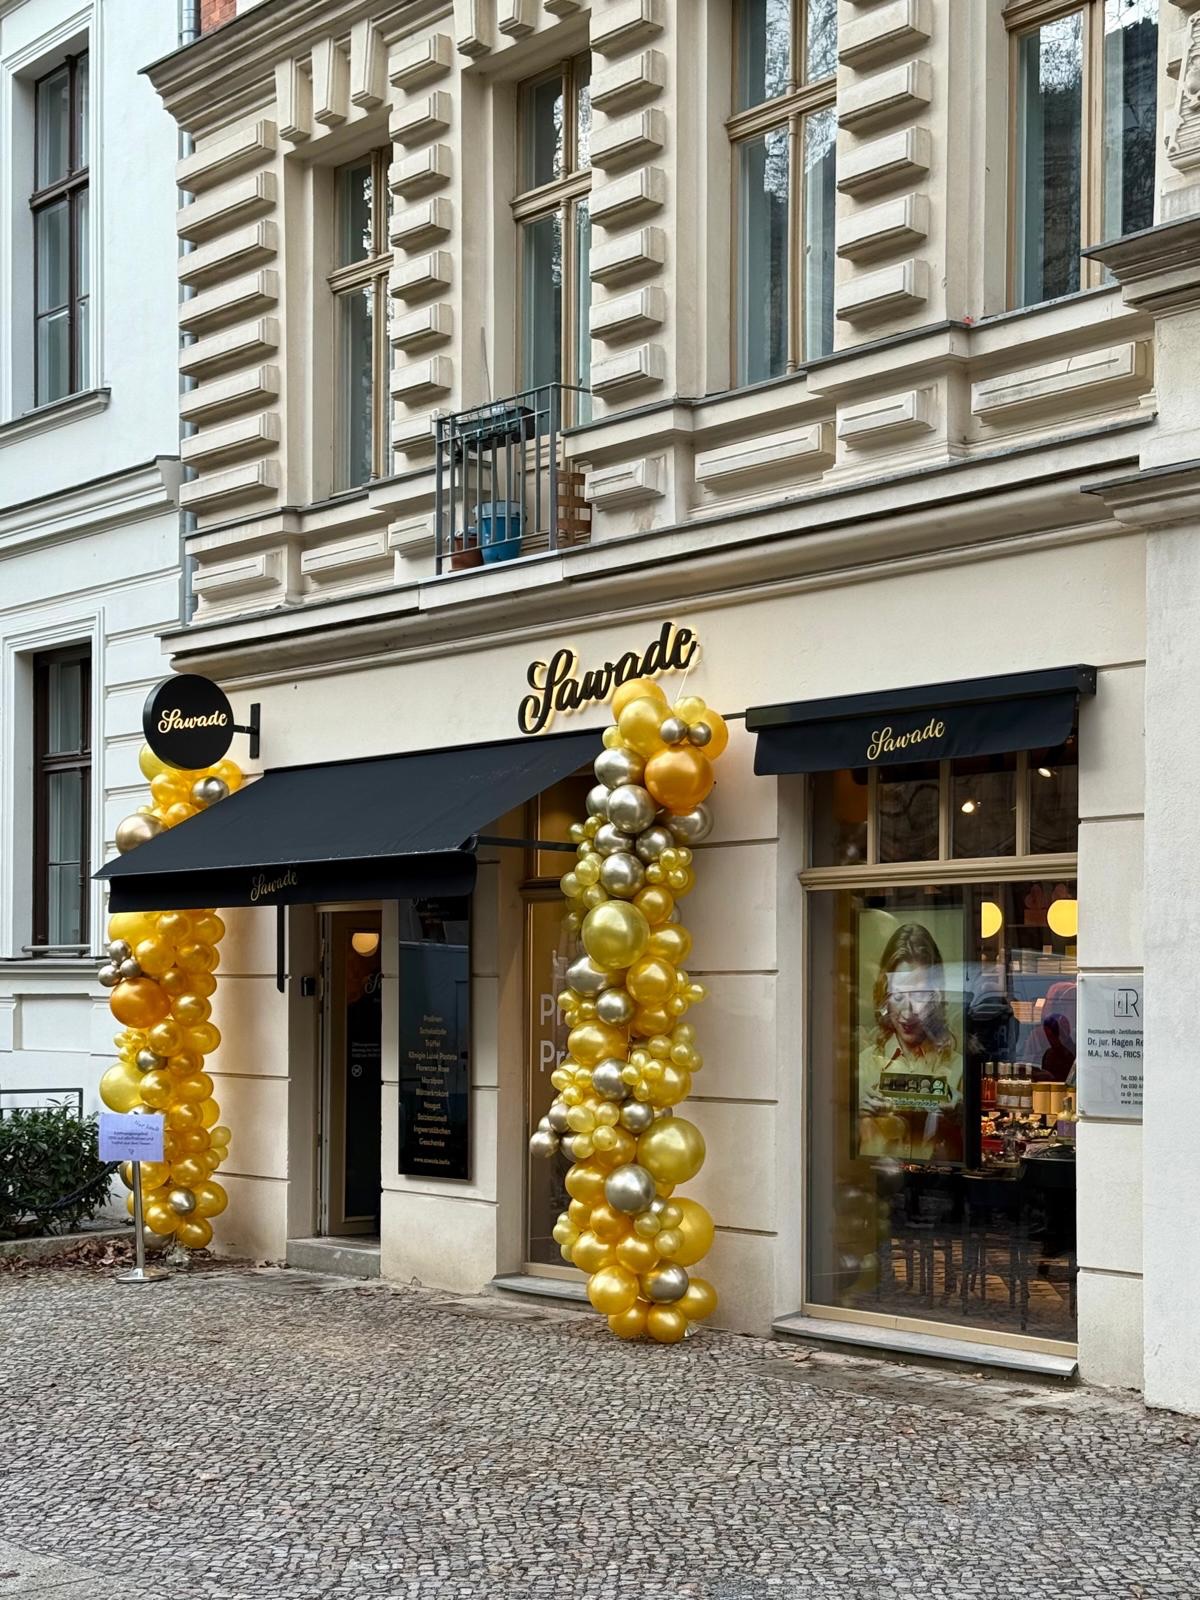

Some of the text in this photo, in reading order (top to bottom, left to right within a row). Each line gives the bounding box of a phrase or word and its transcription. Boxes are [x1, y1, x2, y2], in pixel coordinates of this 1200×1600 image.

[518, 622, 697, 734] Sawade
[157, 708, 228, 734] Sawade
[866, 718, 946, 761] Sawade
[250, 869, 298, 902] Sawade
[1087, 1037, 1097, 1046] Dr.
[1098, 1038, 1109, 1048] jur.
[1111, 1038, 1133, 1048] Hagen
[1123, 1051, 1141, 1059] FRICS
